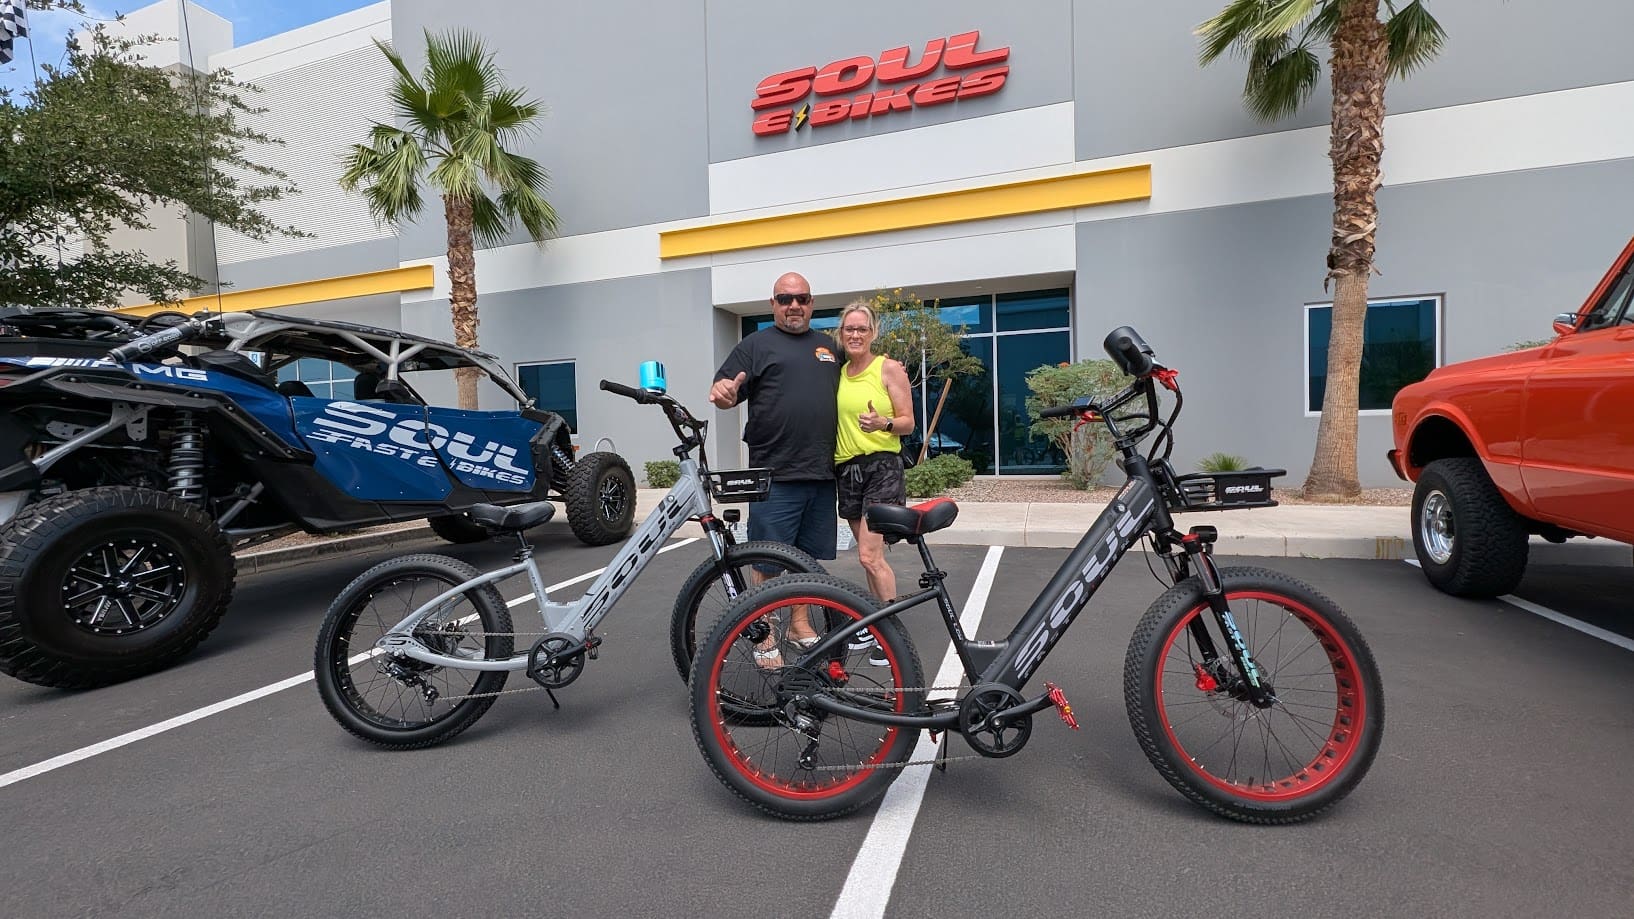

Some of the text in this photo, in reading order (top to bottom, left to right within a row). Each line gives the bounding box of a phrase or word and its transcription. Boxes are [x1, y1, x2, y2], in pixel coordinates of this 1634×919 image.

[751, 30, 1010, 111] SOUL
[752, 65, 1009, 137] E BIKES
[306, 428, 419, 461] FAST
[456, 461, 527, 485] BIKES
[313, 401, 529, 475] SOUL
[583, 490, 695, 629] SOUL
[1014, 498, 1154, 679] SOUL
